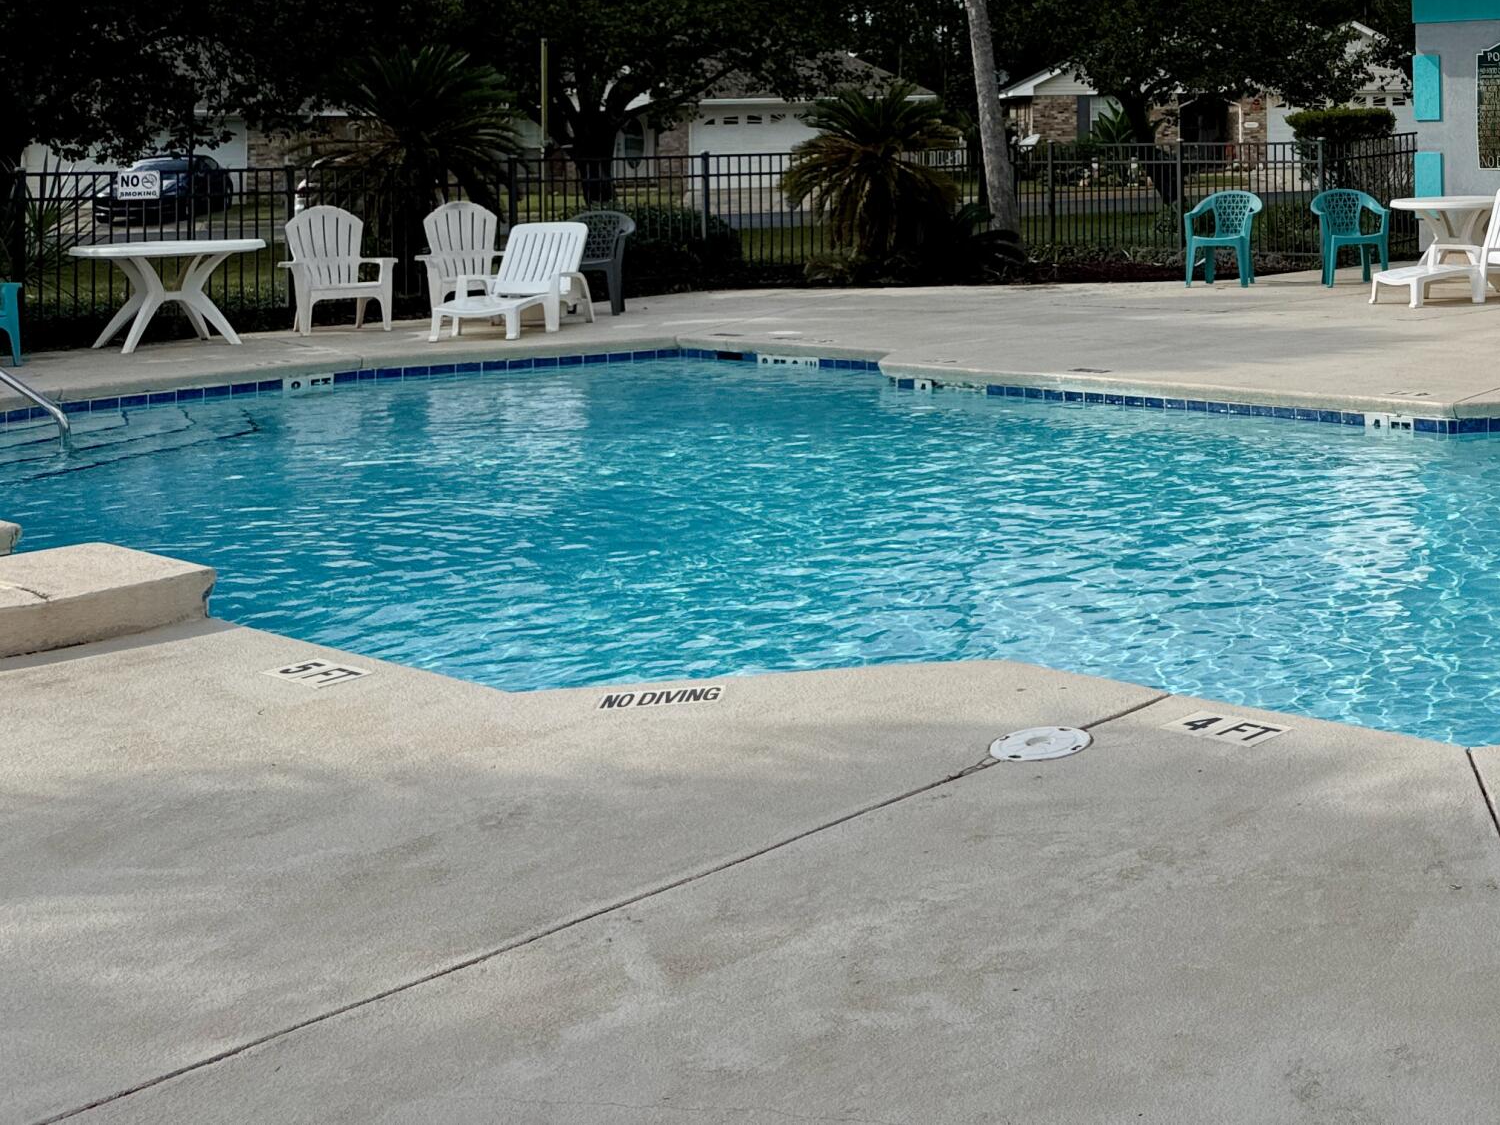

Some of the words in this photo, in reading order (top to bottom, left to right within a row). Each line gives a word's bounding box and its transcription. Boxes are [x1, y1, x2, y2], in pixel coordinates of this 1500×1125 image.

[1481, 156, 1494, 168] NO
[121, 175, 139, 187] NO
[280, 662, 325, 674] 5
[302, 668, 362, 683] FT
[600, 694, 635, 709] NO
[637, 687, 721, 706] DIVING
[1183, 717, 1223, 730] 4
[1216, 723, 1282, 741] FT
